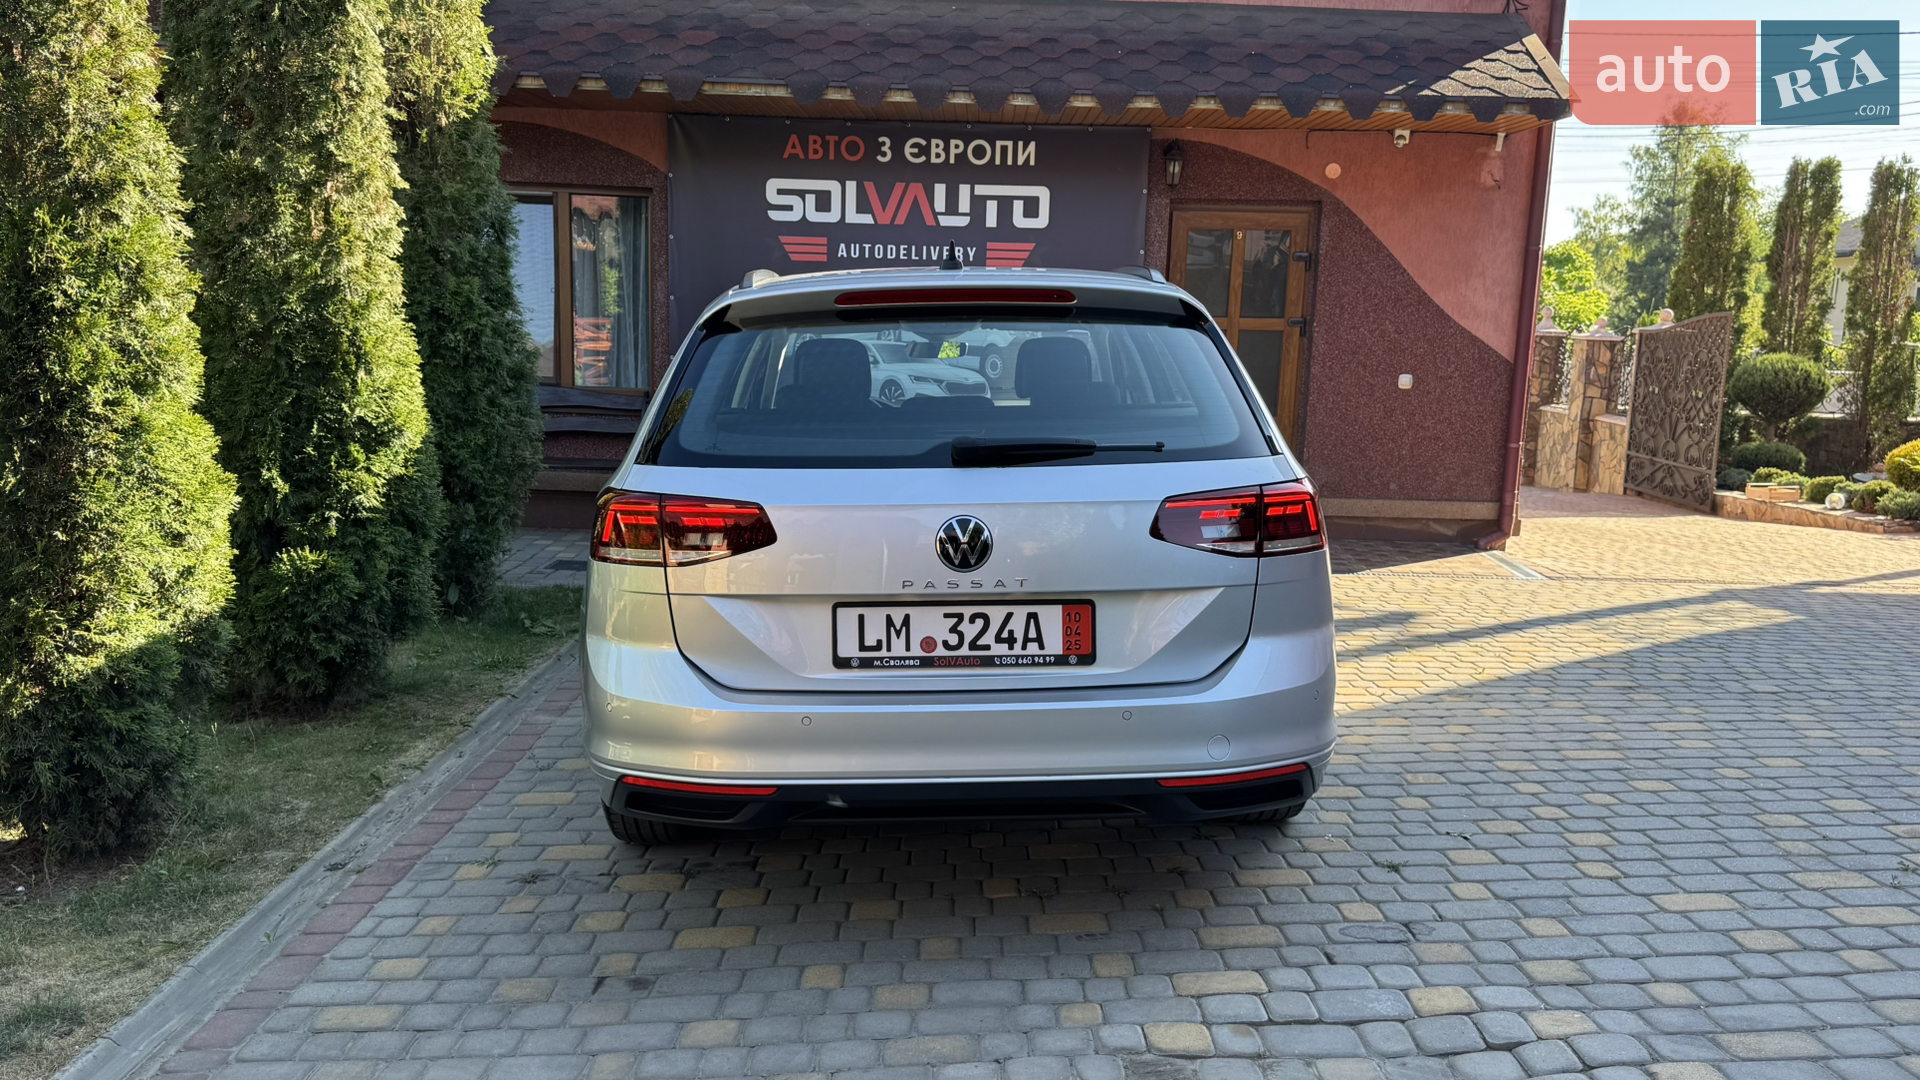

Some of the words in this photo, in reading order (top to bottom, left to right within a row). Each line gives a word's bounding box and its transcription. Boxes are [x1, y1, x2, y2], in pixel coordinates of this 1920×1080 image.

[783, 134, 865, 162] АВТО
[904, 136, 1036, 166] ЄВРОПИ
[765, 177, 1051, 229] SOLVAUTO
[902, 578, 1028, 589] PASSAT
[1065, 611, 1081, 623] 10
[858, 613, 911, 652] LM
[941, 611, 1046, 651] 324A
[1065, 625, 1081, 636] 04
[1065, 639, 1081, 650] 25
[933, 657, 981, 667] SolVAuto
[1001, 656, 1017, 665] 050
[1018, 656, 1033, 665] 660
[1034, 656, 1044, 664] 94
[1045, 656, 1055, 664] 99
